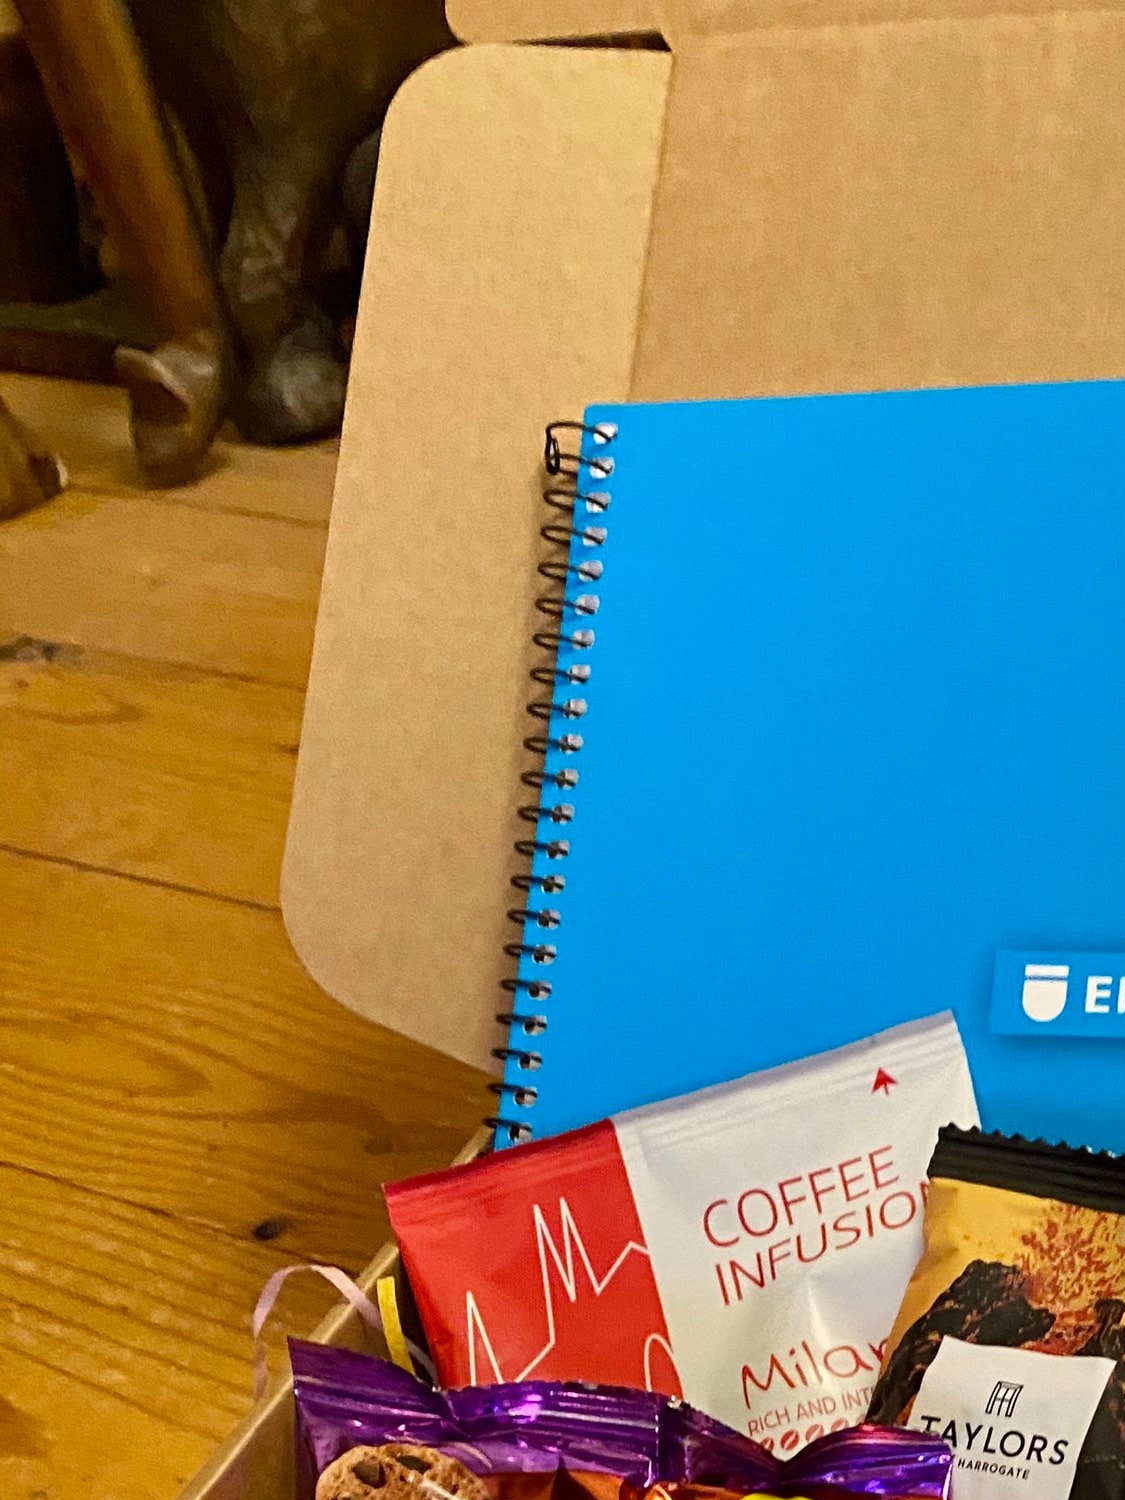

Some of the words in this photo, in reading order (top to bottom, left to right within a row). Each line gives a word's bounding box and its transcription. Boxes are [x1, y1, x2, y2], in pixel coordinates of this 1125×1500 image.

[703, 1144, 900, 1248] COFFEE
[747, 1405, 791, 1437] RICH
[796, 1395, 837, 1421] AND
[841, 1383, 875, 1411] INT
[920, 1414, 1069, 1465] TAYLORS
[957, 1458, 1031, 1481] HARROGATE
